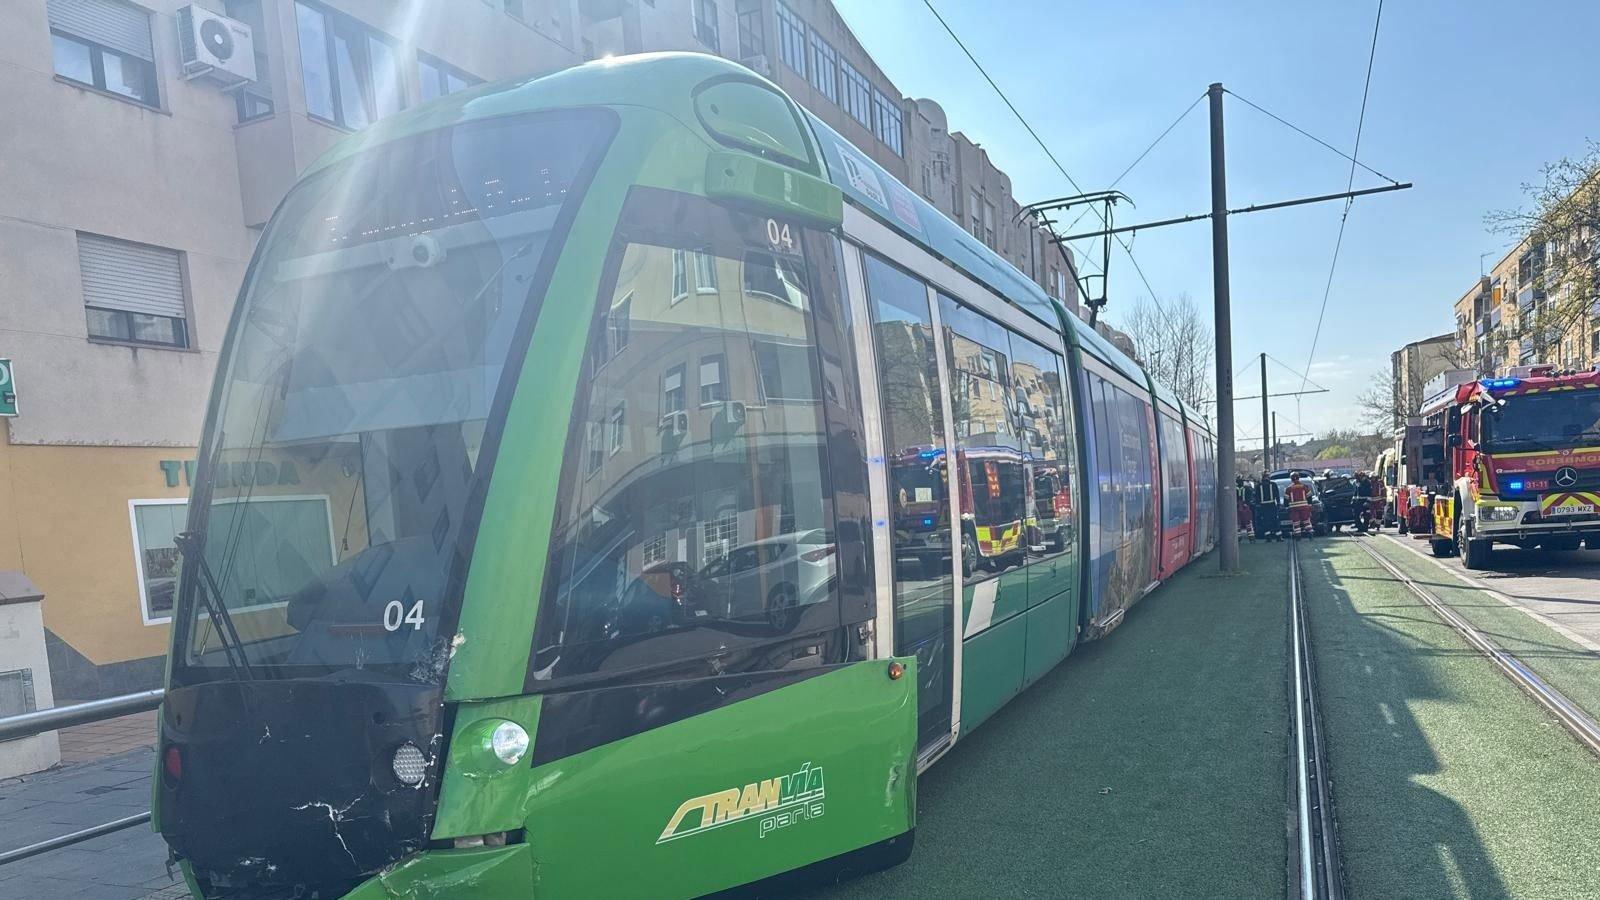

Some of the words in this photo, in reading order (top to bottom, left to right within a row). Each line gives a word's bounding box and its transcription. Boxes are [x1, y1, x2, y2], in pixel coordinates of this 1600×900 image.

[767, 218, 793, 248] 04
[383, 599, 425, 632] 04
[655, 761, 825, 845] TRANVÍA
[759, 802, 825, 839] parla
